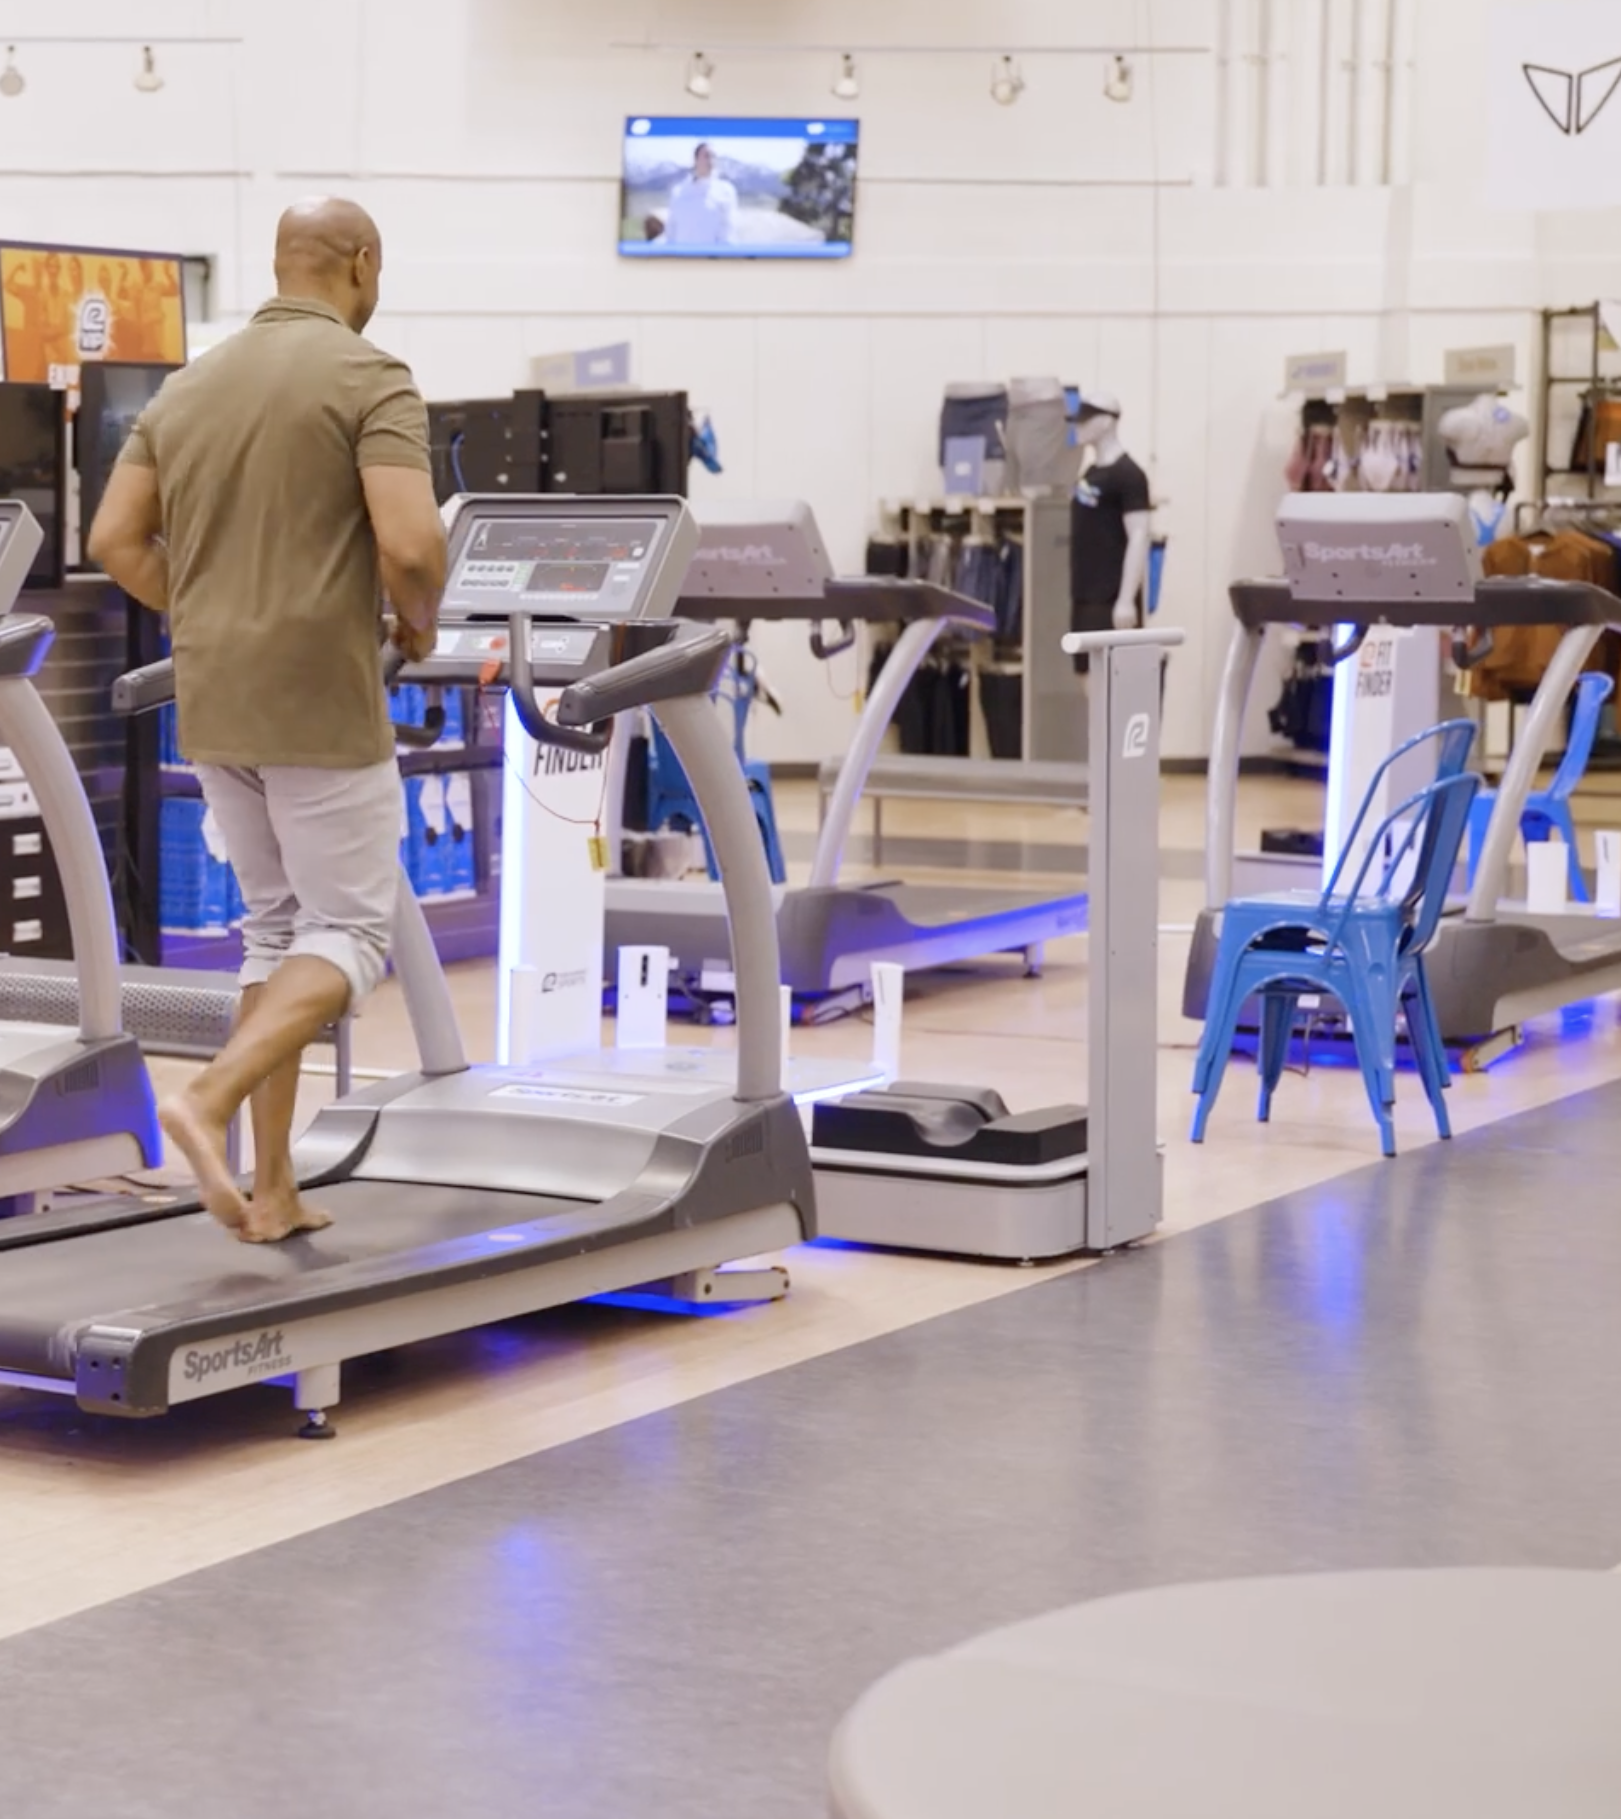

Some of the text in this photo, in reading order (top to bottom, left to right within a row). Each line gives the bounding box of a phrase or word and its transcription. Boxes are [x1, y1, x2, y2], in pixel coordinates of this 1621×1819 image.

[1304, 542, 1423, 562] SportsArt
[183, 1329, 284, 1382] SportsArt
[247, 1355, 292, 1376] FITNESS
